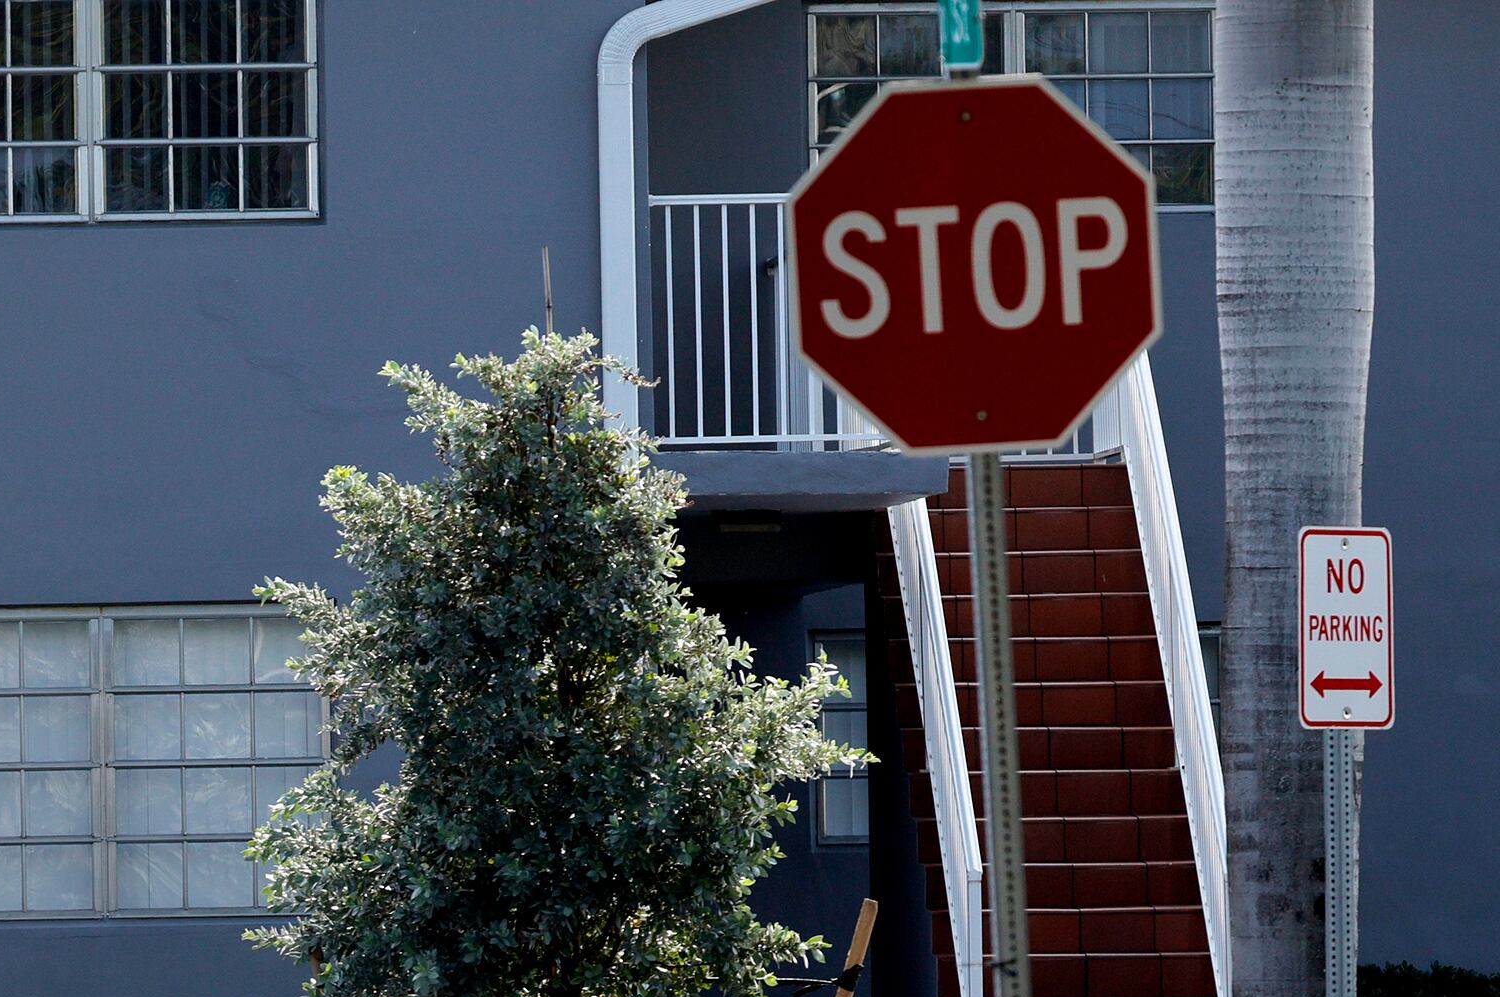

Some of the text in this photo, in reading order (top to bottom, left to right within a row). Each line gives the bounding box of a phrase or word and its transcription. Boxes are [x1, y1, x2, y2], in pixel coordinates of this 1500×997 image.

[820, 196, 1128, 339] STOP
[1326, 558, 1364, 594] NO
[1309, 615, 1383, 643] PARKING
